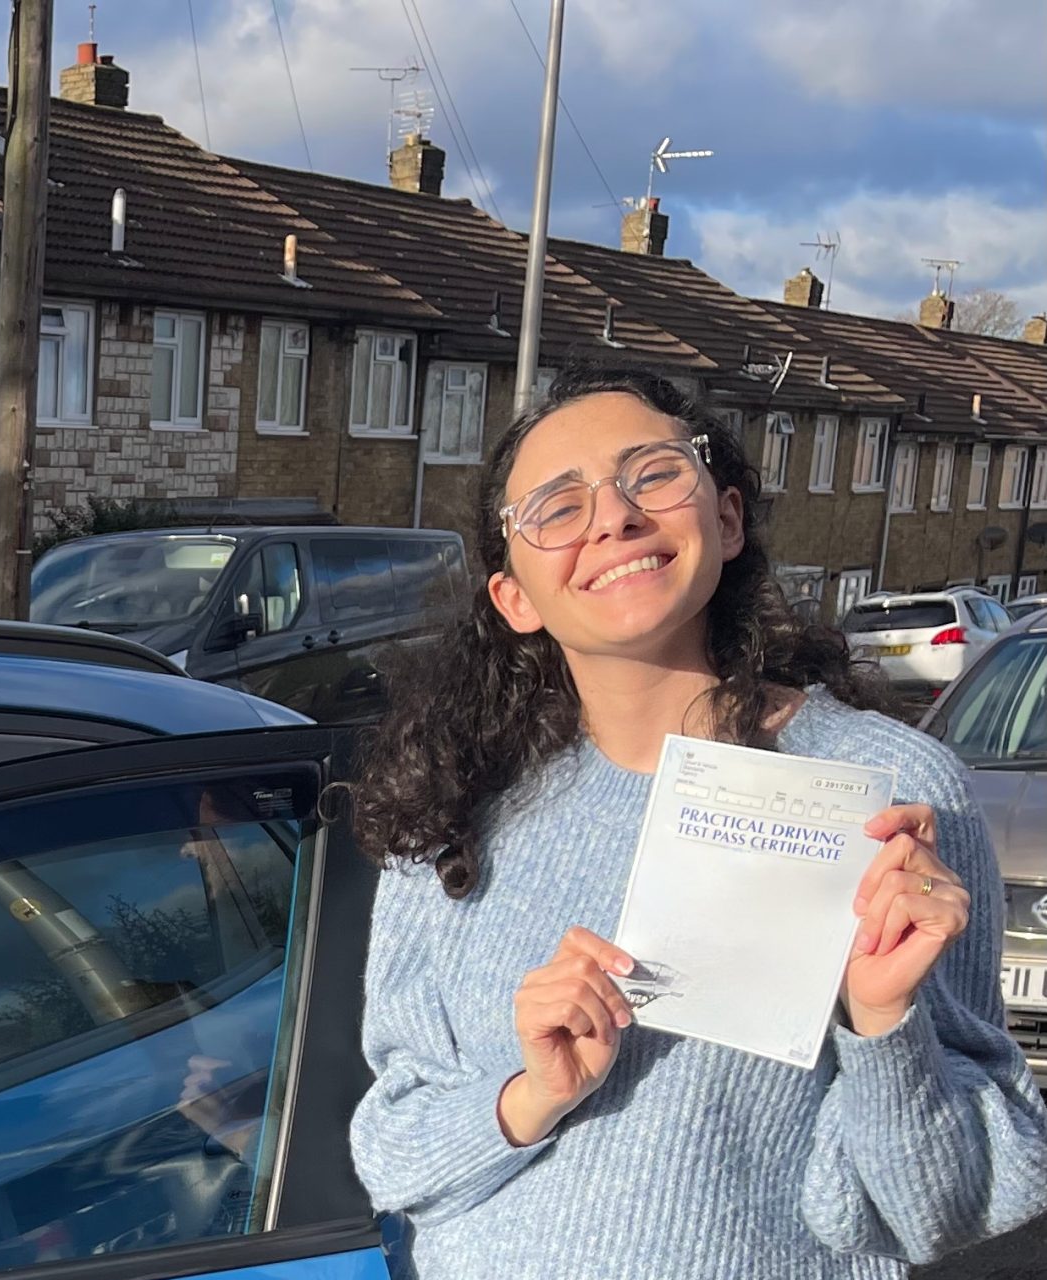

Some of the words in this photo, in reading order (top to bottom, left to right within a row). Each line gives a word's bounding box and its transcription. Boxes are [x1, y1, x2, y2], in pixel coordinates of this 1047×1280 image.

[677, 822, 709, 838] TEST
[712, 830, 746, 846] PASS
[749, 836, 842, 861] CERTIFICATE
[680, 806, 766, 835] PRACTICAL
[771, 823, 847, 847] DRIVING
